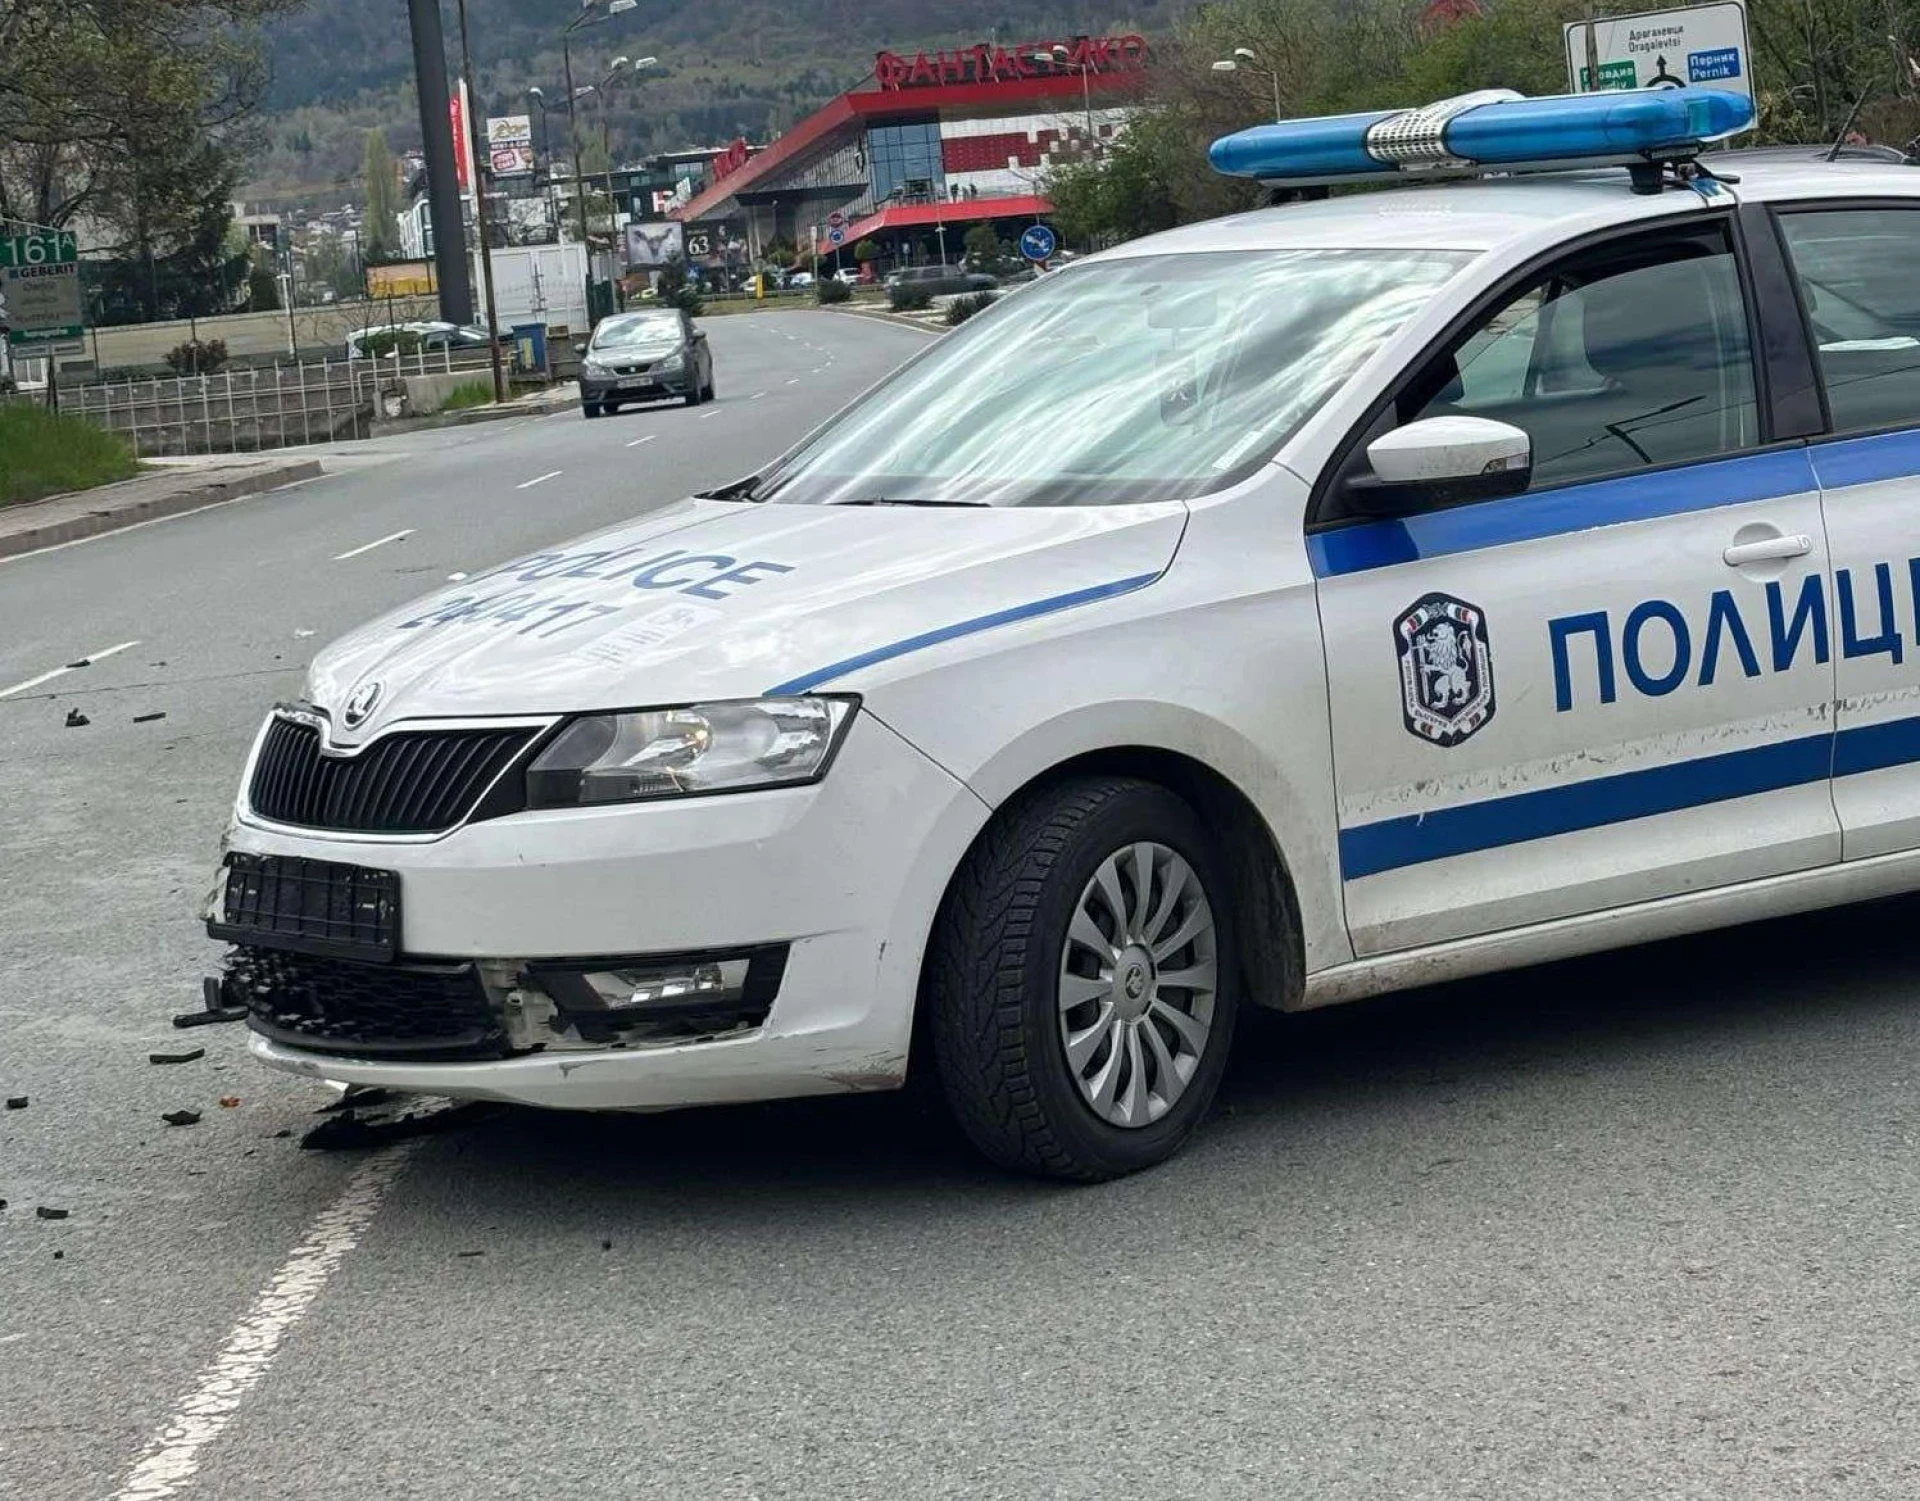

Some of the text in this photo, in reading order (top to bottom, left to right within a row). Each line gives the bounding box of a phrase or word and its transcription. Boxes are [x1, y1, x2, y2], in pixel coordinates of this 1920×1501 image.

[1690, 53, 1735, 67] Перник
[1692, 64, 1730, 80] Pernik
[688, 235, 710, 255] 63
[21, 263, 74, 277] GEBERIT
[466, 547, 796, 601] POLICE
[1548, 557, 1920, 712] ПОЛИЦ
